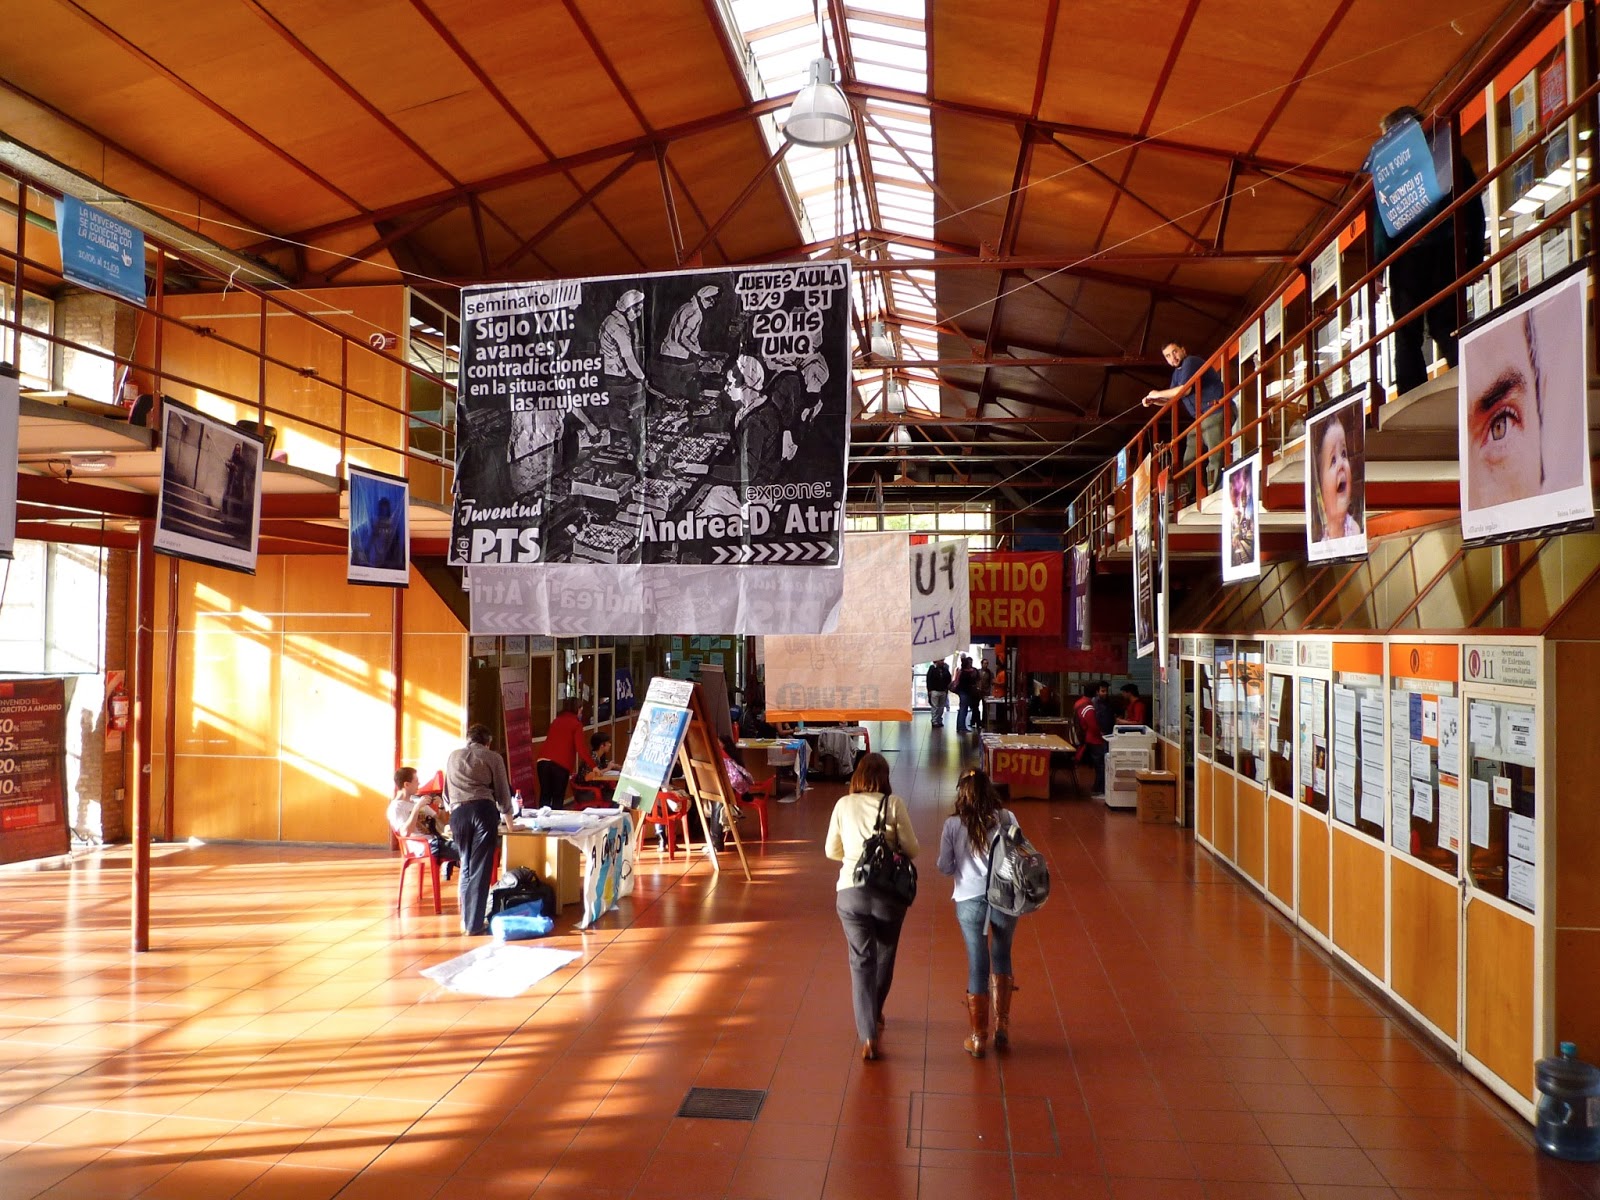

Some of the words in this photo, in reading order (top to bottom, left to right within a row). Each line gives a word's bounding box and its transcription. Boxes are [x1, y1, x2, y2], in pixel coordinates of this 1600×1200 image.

[1413, 172, 1424, 185] LA
[1416, 183, 1426, 195] SE
[1389, 179, 1415, 204] IGUALDAD
[1396, 191, 1418, 211] CONECTA
[79, 207, 88, 220] LA
[90, 211, 132, 241] UNIVERSIDAD
[1392, 200, 1423, 230] UNIVERSIDAD
[78, 227, 87, 239] LA
[88, 232, 119, 252] IGUALDAD
[80, 217, 88, 229] SE
[90, 222, 118, 243] CONECTA
[119, 235, 132, 249] CON
[738, 273, 792, 290] JUEVES
[796, 269, 842, 287] AULA
[745, 291, 781, 307] 13/9
[808, 289, 829, 306] 51
[475, 315, 530, 343] Siglo
[534, 309, 575, 334] XXI:
[756, 313, 786, 335] 20
[791, 311, 820, 332] HS
[476, 341, 555, 361] avances
[559, 338, 571, 358] y
[764, 334, 811, 355] UNQ
[467, 357, 602, 379] contradicciones
[470, 384, 489, 396] en
[492, 380, 506, 395] la
[509, 374, 576, 394] situación
[579, 372, 598, 388] de
[510, 394, 535, 412] las
[538, 390, 609, 413] mujeres
[747, 481, 833, 511] expone:
[460, 498, 542, 526] Juventud
[641, 509, 744, 542] Andrea
[470, 527, 541, 563] PTS
[1483, 659, 1495, 680] 11
[33, 703, 62, 712] AHORRO
[996, 752, 1045, 777] PSTU
